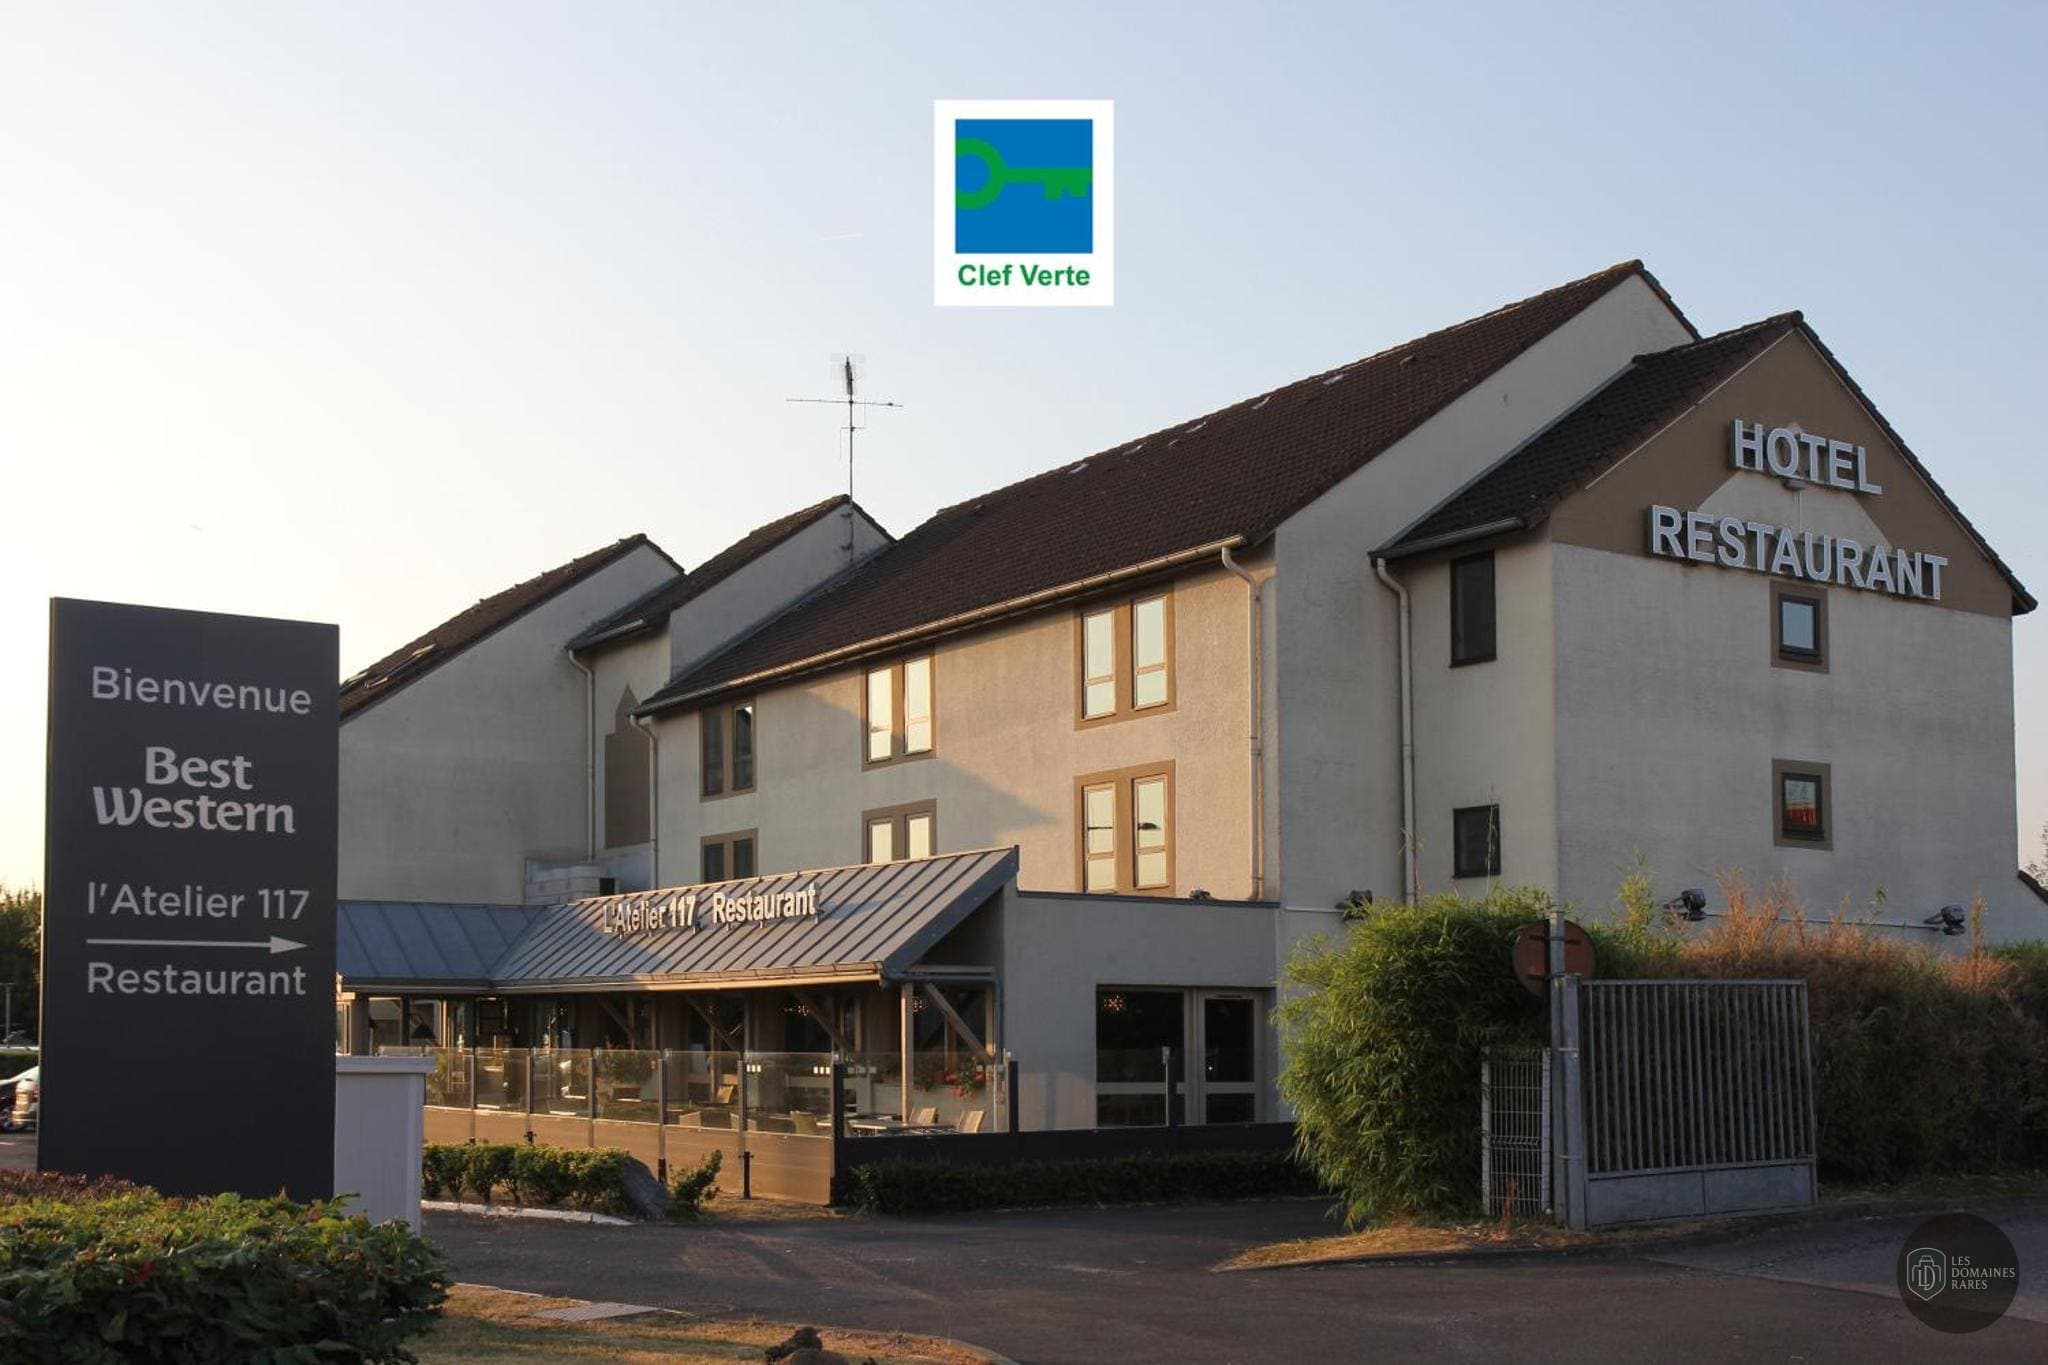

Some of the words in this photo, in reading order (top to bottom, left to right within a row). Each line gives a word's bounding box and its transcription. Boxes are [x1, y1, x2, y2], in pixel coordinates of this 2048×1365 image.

[1731, 418, 1882, 495] HOTEL
[1650, 504, 1948, 600] RESTAURANT
[92, 666, 311, 714] Bienvenue
[145, 746, 253, 790] Best
[93, 786, 295, 833] Western
[88, 882, 244, 917] l'Atelier
[258, 888, 310, 919] 117
[603, 902, 668, 933] L'Atelier
[668, 895, 697, 927] 117
[712, 882, 816, 924] Restaurant
[87, 962, 306, 995] Restaurant
